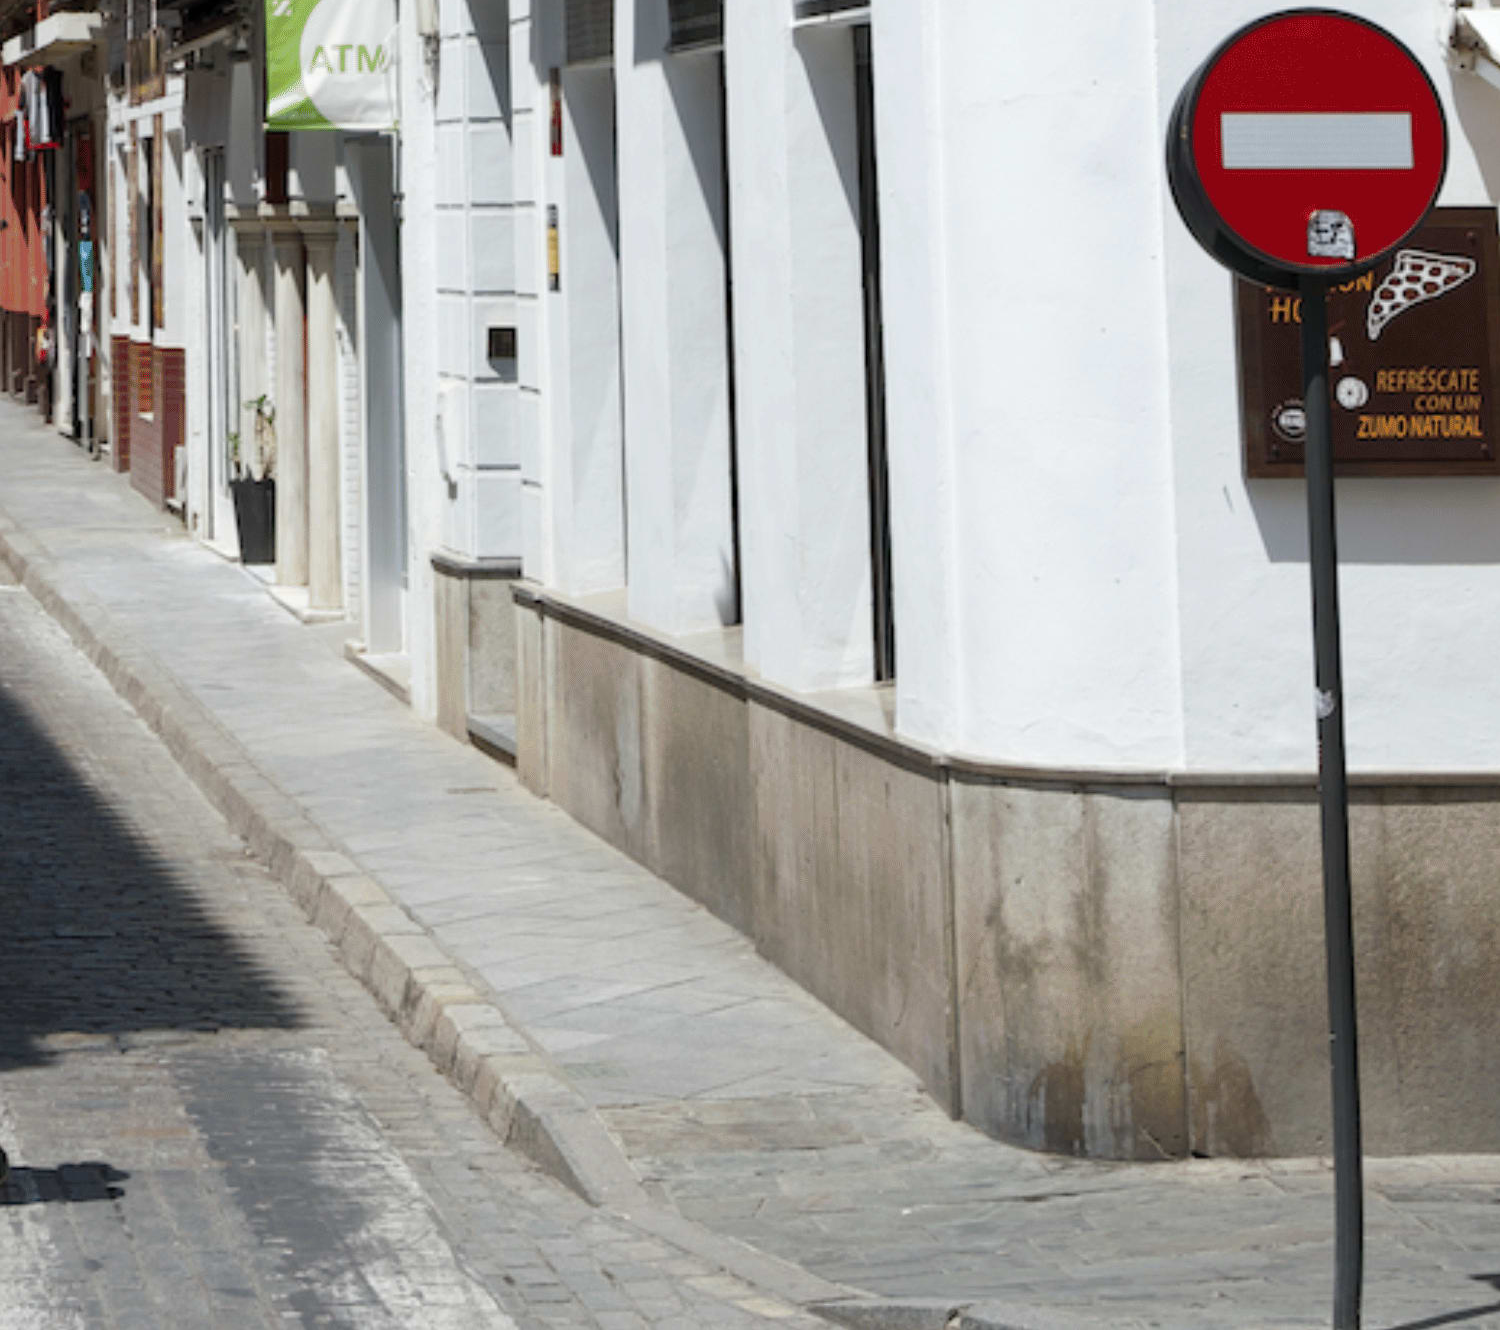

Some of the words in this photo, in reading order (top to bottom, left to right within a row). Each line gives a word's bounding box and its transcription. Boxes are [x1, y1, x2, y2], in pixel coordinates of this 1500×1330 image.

[309, 43, 386, 74] ATM
[1376, 368, 1480, 393] REFRÉSCATE
[1414, 395, 1455, 411] CON
[1455, 395, 1482, 411] UN
[1356, 415, 1409, 438] ZUMO
[1411, 414, 1483, 438] NATURAL
